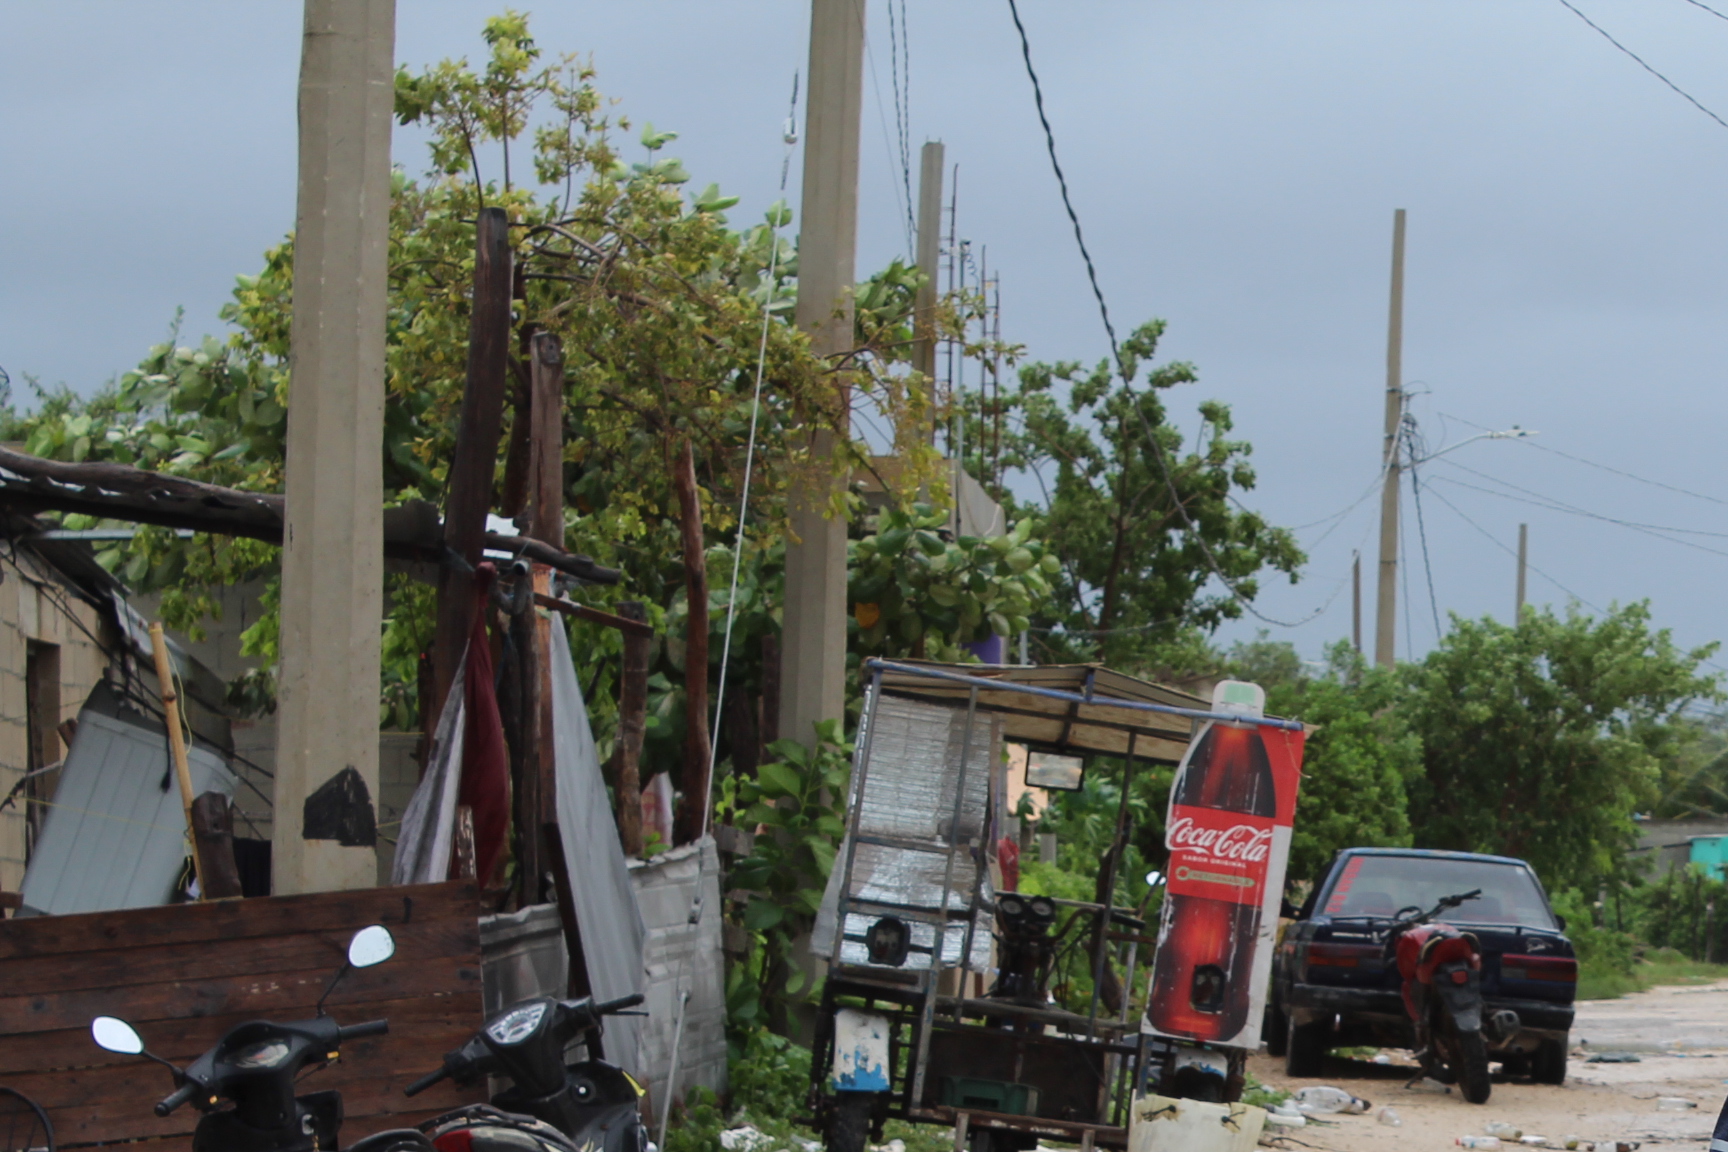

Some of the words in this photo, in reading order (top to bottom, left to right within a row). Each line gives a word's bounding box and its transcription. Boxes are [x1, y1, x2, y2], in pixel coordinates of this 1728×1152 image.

[1165, 817, 1274, 862] Coca-Cola
[1182, 854, 1208, 863] SABOR
[1210, 858, 1247, 869] ORIGINAL
